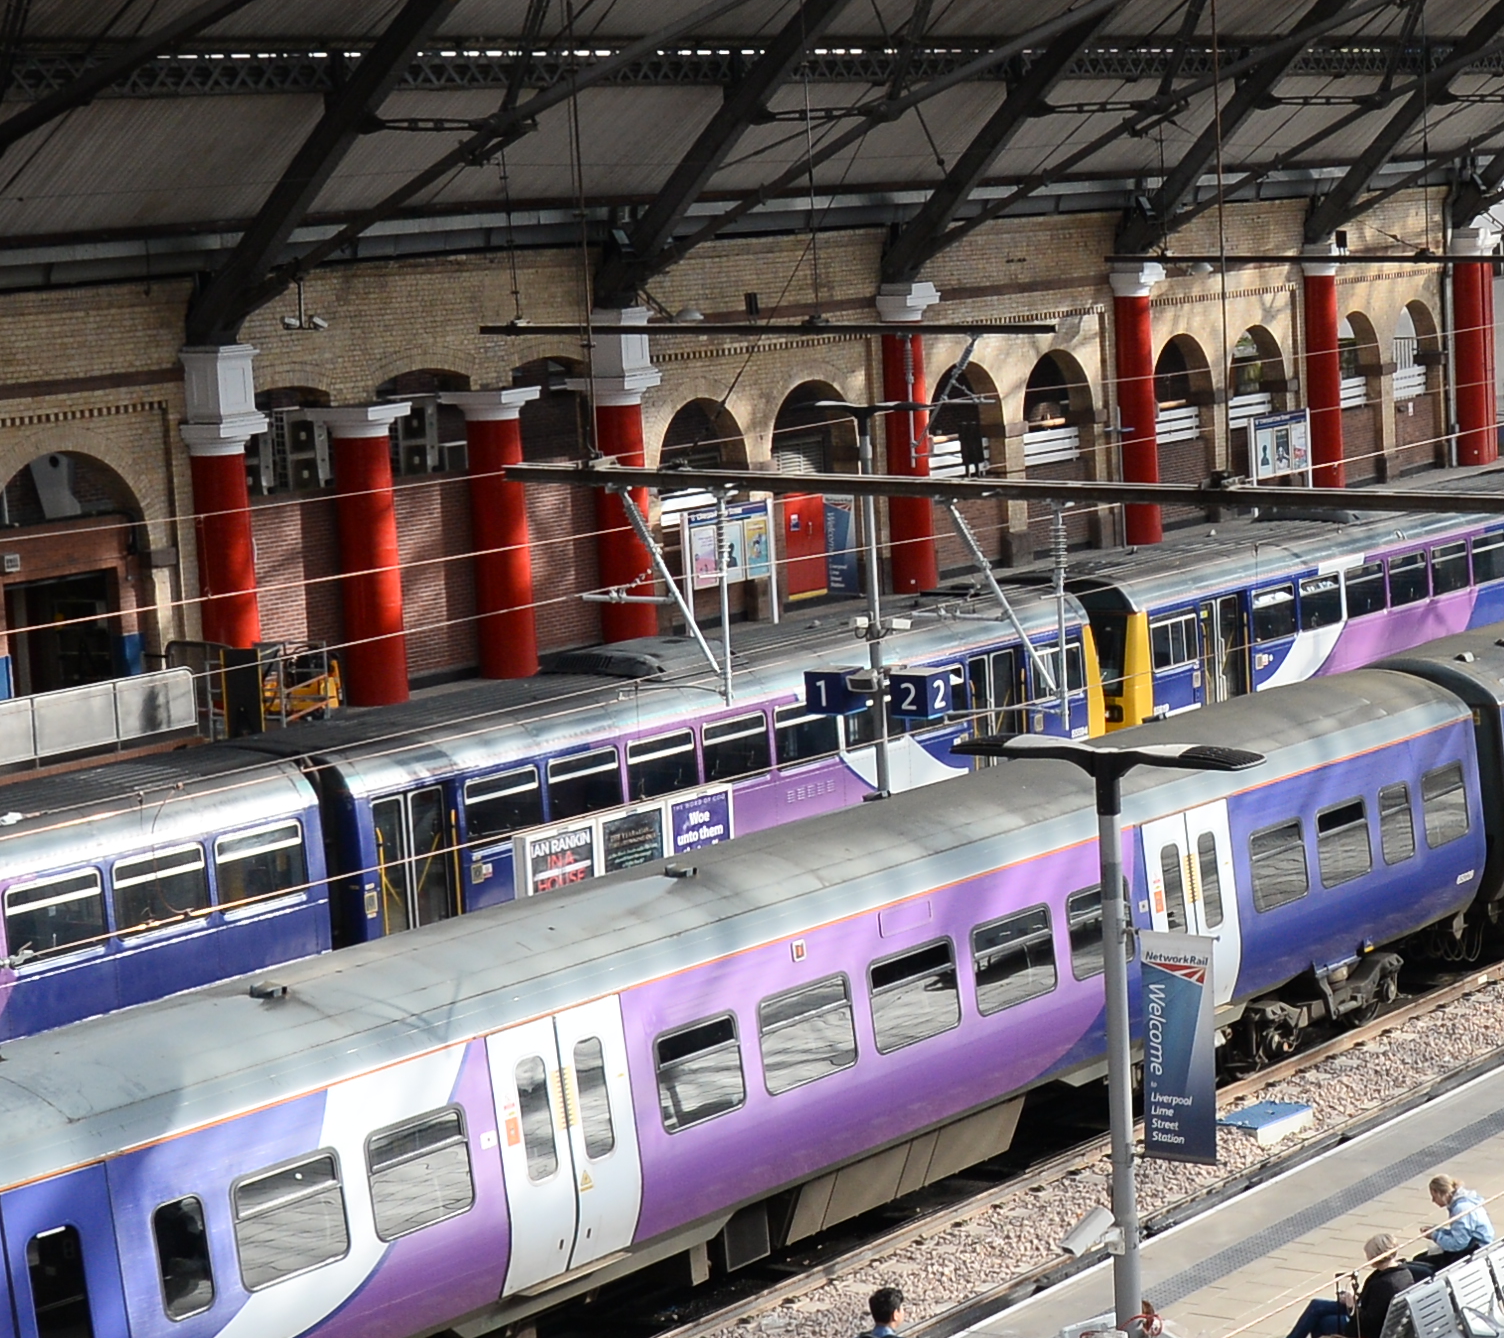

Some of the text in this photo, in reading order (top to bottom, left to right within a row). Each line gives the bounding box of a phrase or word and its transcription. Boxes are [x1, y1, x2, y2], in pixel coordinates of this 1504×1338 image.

[816, 679, 827, 707] 1
[900, 682, 917, 710] 2
[932, 679, 947, 709] 2
[689, 810, 710, 825] Woe
[531, 840, 550, 859] IAN
[551, 828, 591, 854] RANKIN
[677, 830, 699, 846] unto
[699, 823, 724, 840] them
[547, 850, 575, 870] IN A
[537, 867, 587, 893] HOUSE
[1145, 950, 1209, 966] NetworkRail
[1148, 983, 1167, 1076] Welcome
[1150, 1092, 1193, 1106] Liverpool
[1151, 1105, 1175, 1117] Lime
[1151, 1118, 1179, 1131] Street
[1152, 1131, 1186, 1145] Station
